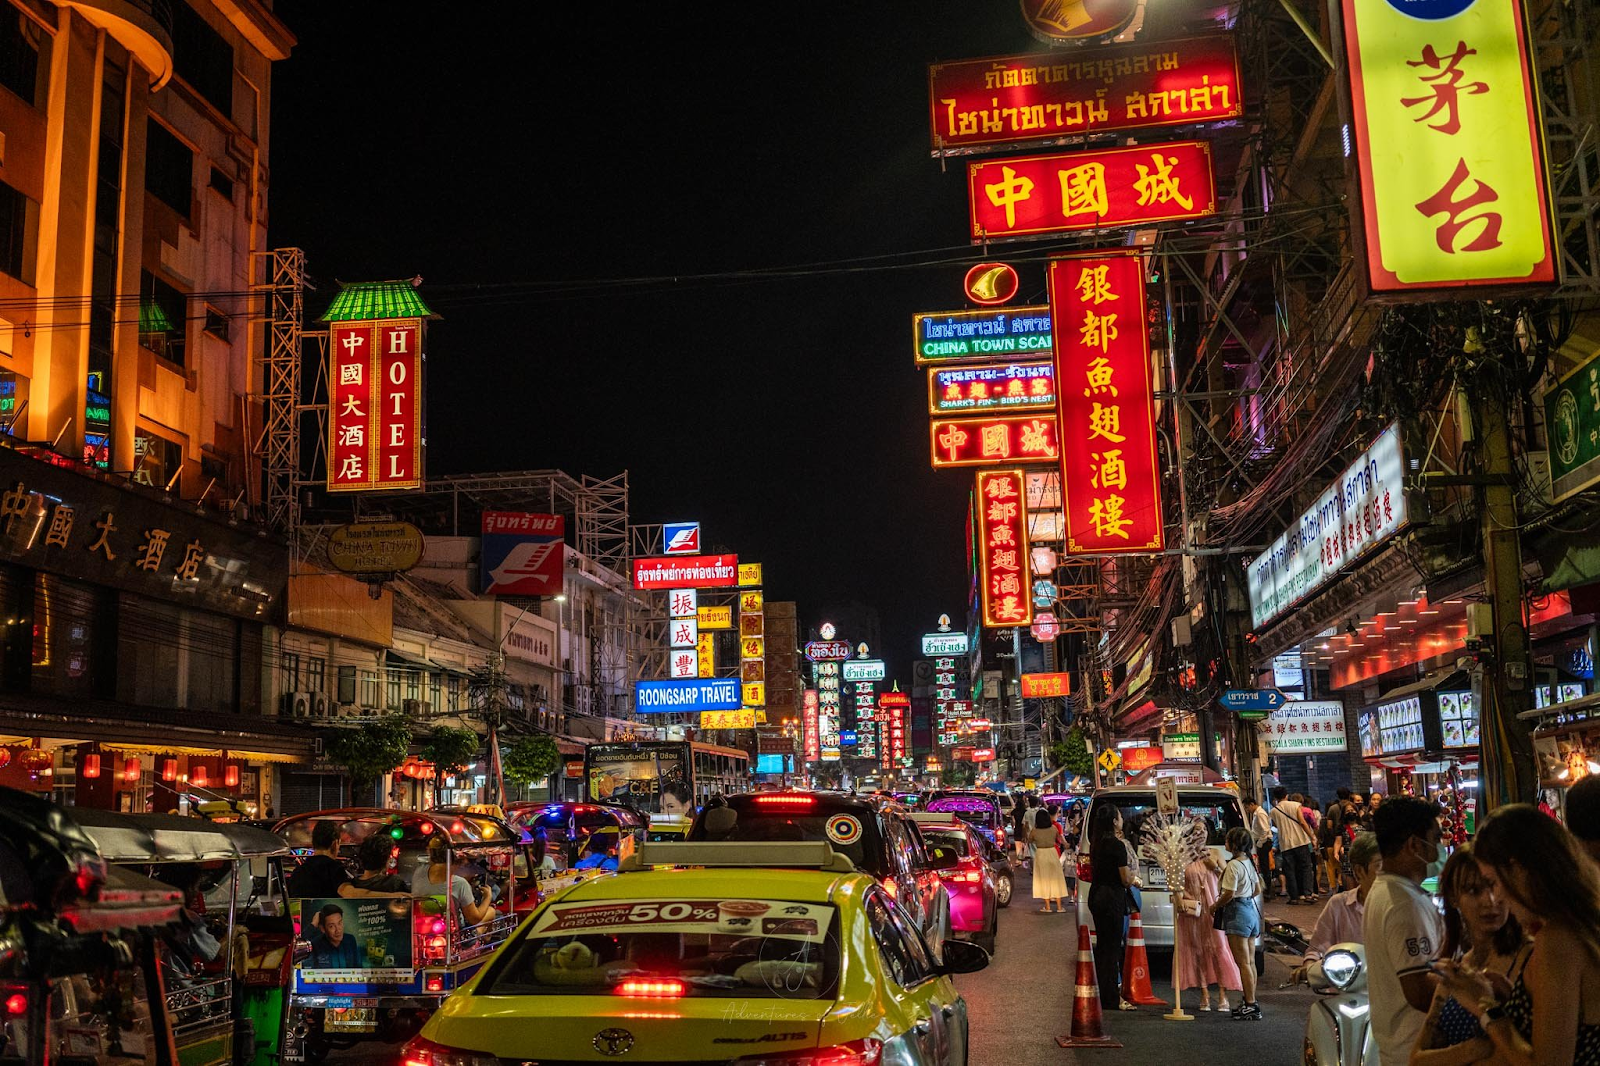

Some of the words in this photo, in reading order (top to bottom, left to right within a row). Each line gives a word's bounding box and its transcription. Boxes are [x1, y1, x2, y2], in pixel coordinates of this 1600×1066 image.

[941, 88, 1109, 137] ไชน่าทาวน์
[1125, 75, 1231, 120] สกาล่า
[1399, 40, 1503, 254] 茅台
[985, 153, 1194, 228] 中國城
[923, 341, 968, 355] CHINA
[972, 338, 1015, 352] TOWN
[338, 332, 366, 480] 中國大酒店
[388, 331, 408, 478] HOTEL
[940, 398, 975, 408] SHARK'S
[1001, 396, 1028, 405] BIRD'S
[1074, 265, 1134, 540] 銀都魚翅酒樓
[939, 420, 1055, 462] 中國城
[1, 481, 204, 580] 中國大酒店
[485, 513, 561, 533] รุ่งทรัพย์
[984, 476, 1024, 620] 銀都魚翅酒樓
[637, 557, 734, 588] รุ่งทรัพย์การท่องเที่ยว
[671, 594, 694, 677] 振成豐
[639, 685, 698, 706] ROONGSARP
[700, 683, 737, 704] TRAVEL
[1268, 693, 1277, 704] 2
[1316, 736, 1346, 746] RESTAURANT
[630, 781, 659, 794] C&E
[471, 807, 495, 817] TAXI
[628, 903, 717, 922] 50%
